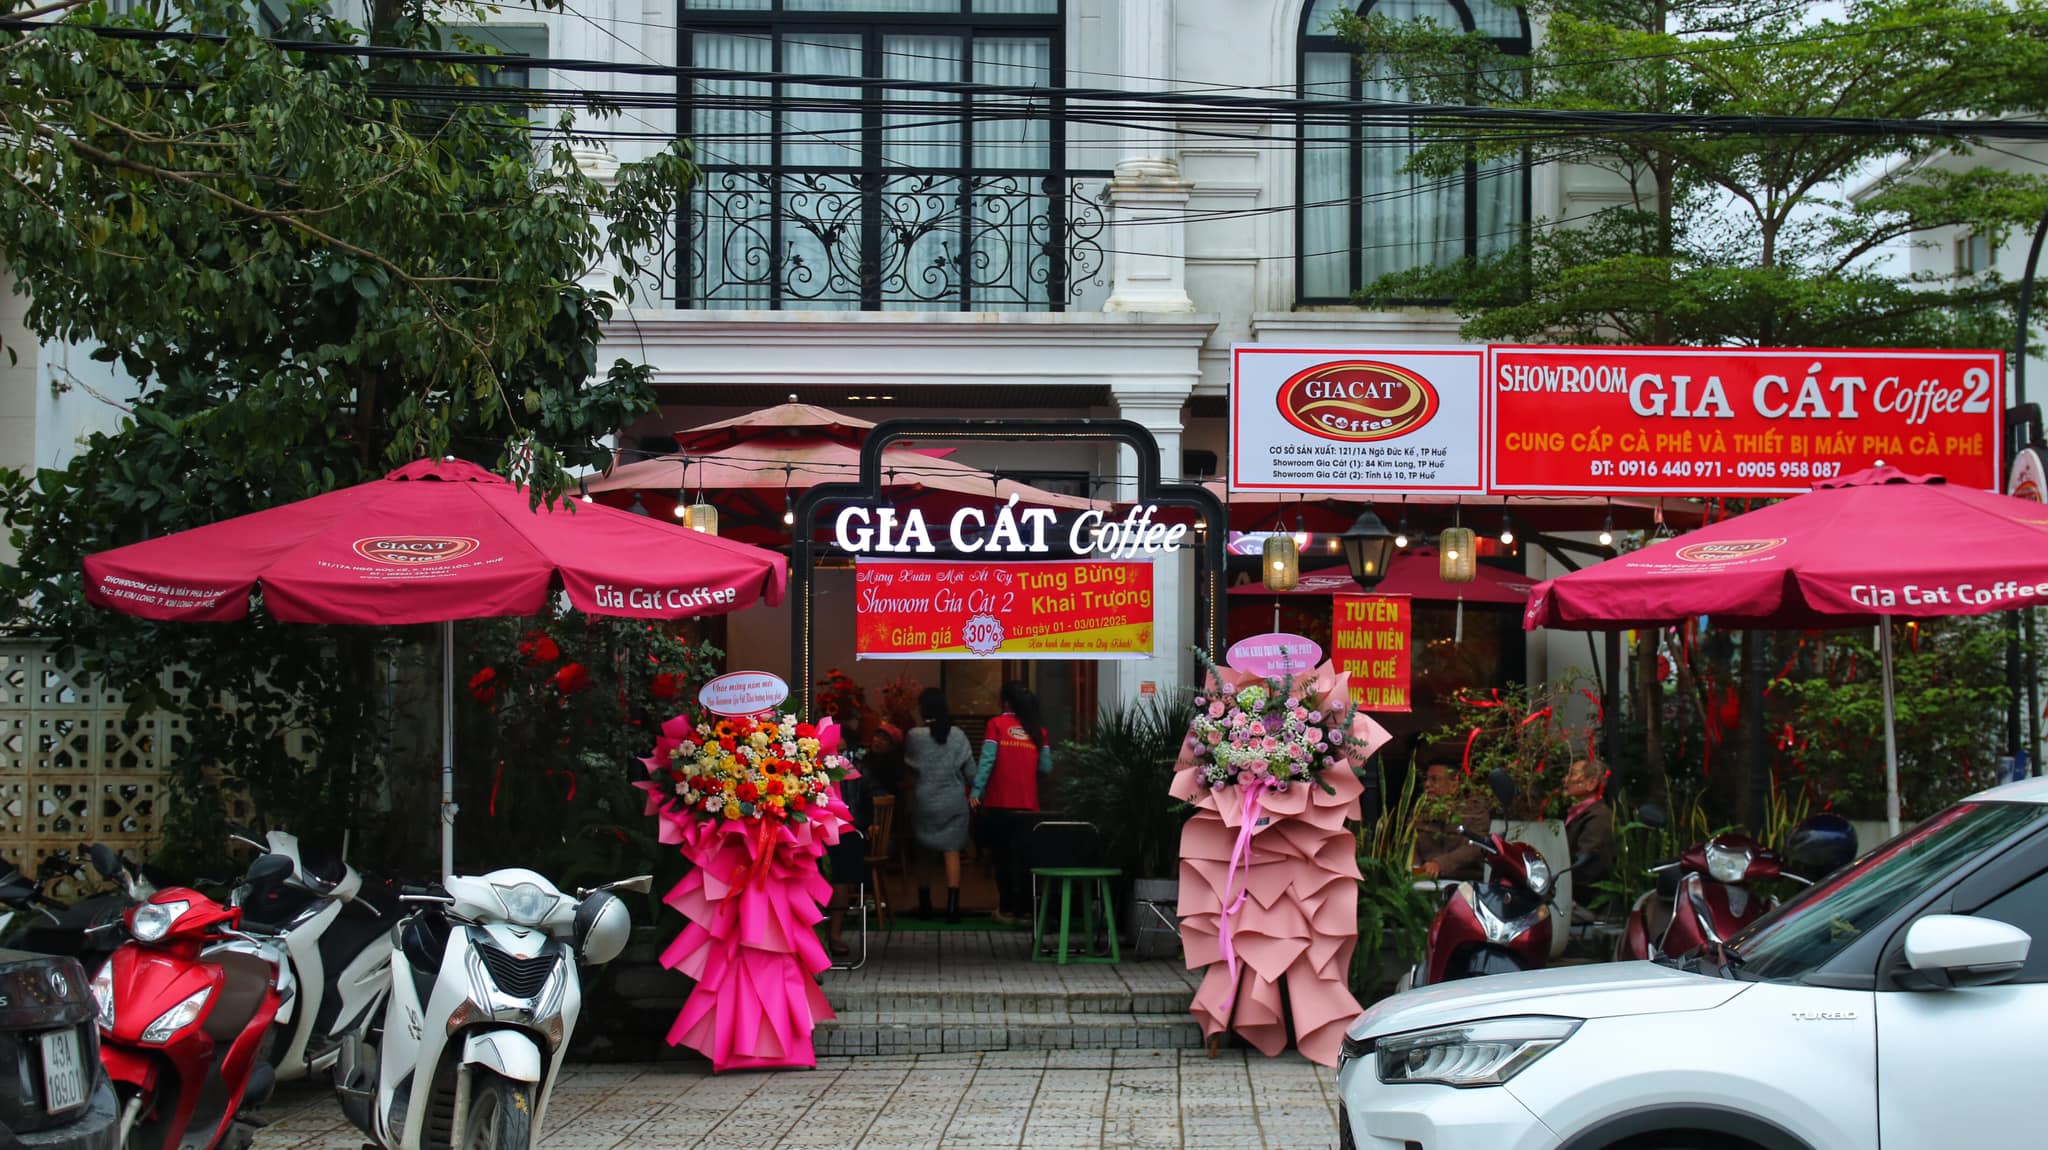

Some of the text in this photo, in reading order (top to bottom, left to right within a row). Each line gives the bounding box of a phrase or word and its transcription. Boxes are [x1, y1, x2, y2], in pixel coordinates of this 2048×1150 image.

[1499, 362, 1990, 425] SHOWROOM GIA CÁT Coffee 2
[1421, 448, 1430, 456] TP
[1505, 426, 1983, 457] CUNG CẤP CÀ PHÊ VÀ THIẾT BỊ MÁY PHA CÀ PHÊ
[1272, 470, 1314, 478] Showroom
[1316, 470, 1330, 478] Gia
[1332, 470, 1346, 478] Cát
[1408, 472, 1418, 480] TP
[1273, 458, 1314, 467] Showroom
[1316, 459, 1330, 468] Gia
[1332, 458, 1346, 468] Cát
[1378, 460, 1392, 468] Kim
[1418, 460, 1427, 468] TP
[1590, 460, 1614, 476] ĐT:
[1619, 461, 1658, 476] 0916
[1662, 461, 1690, 476] 440
[1694, 461, 1722, 477] 971
[1737, 462, 1775, 477] 0905
[1780, 462, 1809, 478] 958
[1812, 462, 1840, 477] 087
[835, 492, 1187, 559] GIA CÁT Coffee
[376, 541, 447, 550] GIACAT
[1074, 564, 1126, 586] Bừng
[594, 584, 737, 610] Gia Cat Coffee
[934, 588, 963, 614] Gia
[968, 588, 996, 613] Cát
[1001, 592, 1015, 613] 2
[1031, 590, 1151, 616] Khai Trương
[1850, 581, 2048, 608] Gia Cat Coffee
[1345, 598, 1398, 622] TUYỂN
[892, 624, 999, 649] Giảm giá 30%
[1026, 622, 1050, 638] ngày
[1053, 622, 1064, 632] 01
[1074, 616, 1127, 630] 03/01/2025
[1337, 626, 1404, 650] NHÂN VIÊN
[1344, 654, 1397, 678] PHA CHẾ
[1383, 684, 1405, 706] BÀN
[52, 1034, 73, 1068] 43A
